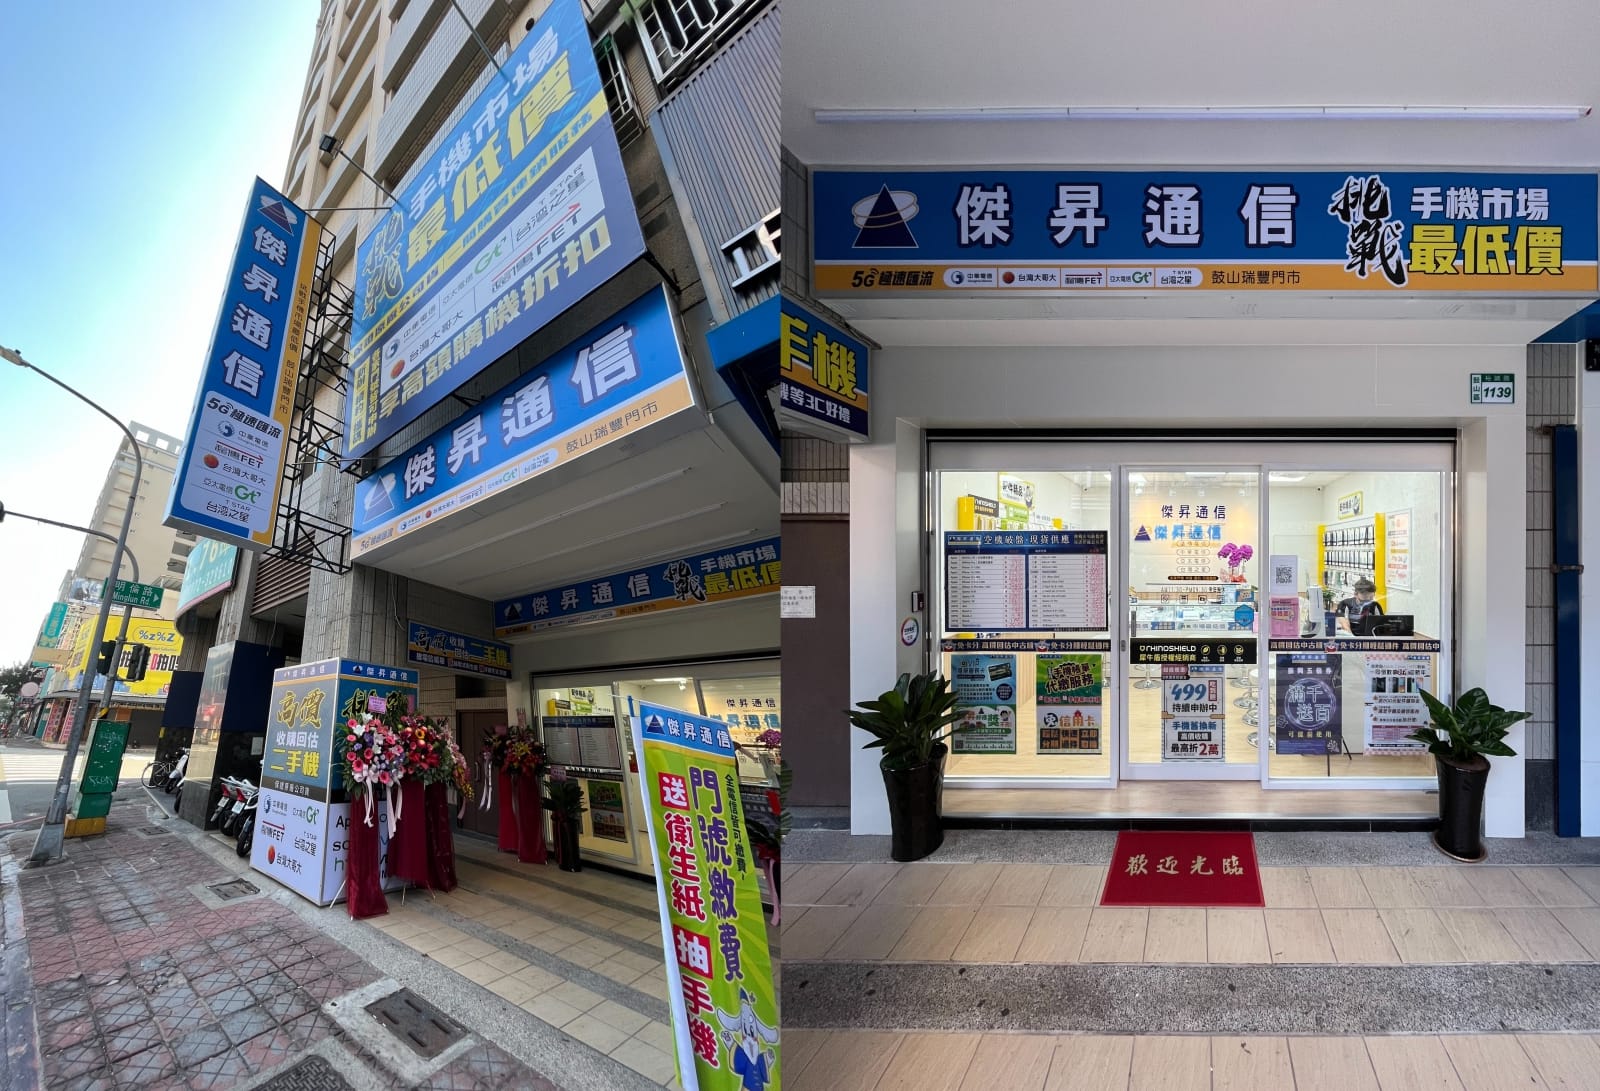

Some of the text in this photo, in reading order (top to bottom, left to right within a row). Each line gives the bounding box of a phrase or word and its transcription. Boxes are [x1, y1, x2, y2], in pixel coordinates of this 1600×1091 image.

[409, 26, 558, 220] 手機市場
[406, 51, 577, 272] 最低價
[955, 185, 1296, 246] 傑昇通信
[1411, 187, 1550, 221] 手機市場
[1408, 224, 1564, 275] 最低價
[1018, 273, 1057, 282] 台灣大哥大
[1160, 275, 1192, 285] 台灣之星
[1211, 270, 1301, 285] 鼓山瑞豐門市
[222, 226, 288, 397] 傑昇通信
[379, 215, 613, 420] 享高額購機折扣
[1483, 387, 1512, 398] 1139
[402, 324, 639, 499] 傑昇通信
[566, 401, 659, 453] 鼓山瑞豐門市
[223, 463, 267, 486] 台灣大哥大
[206, 501, 250, 523] 台灣之星
[1161, 505, 1226, 519] 傑昇通信
[701, 545, 776, 572] 手機市場
[532, 573, 651, 617] 傑昇通信
[366, 667, 408, 680] 傑昇通信
[726, 698, 776, 708] 傑昇通信
[1171, 684, 1207, 701] 499
[277, 688, 326, 728] 高價
[1172, 703, 1218, 713] 持續申辦中
[276, 730, 319, 749] 收購回估
[667, 718, 732, 749] 傑昇通信
[1172, 721, 1217, 731] 手機舊換新
[271, 748, 320, 777] 二手機
[689, 767, 745, 981] 門號繳費
[1124, 853, 1244, 877] 歡迎光臨
